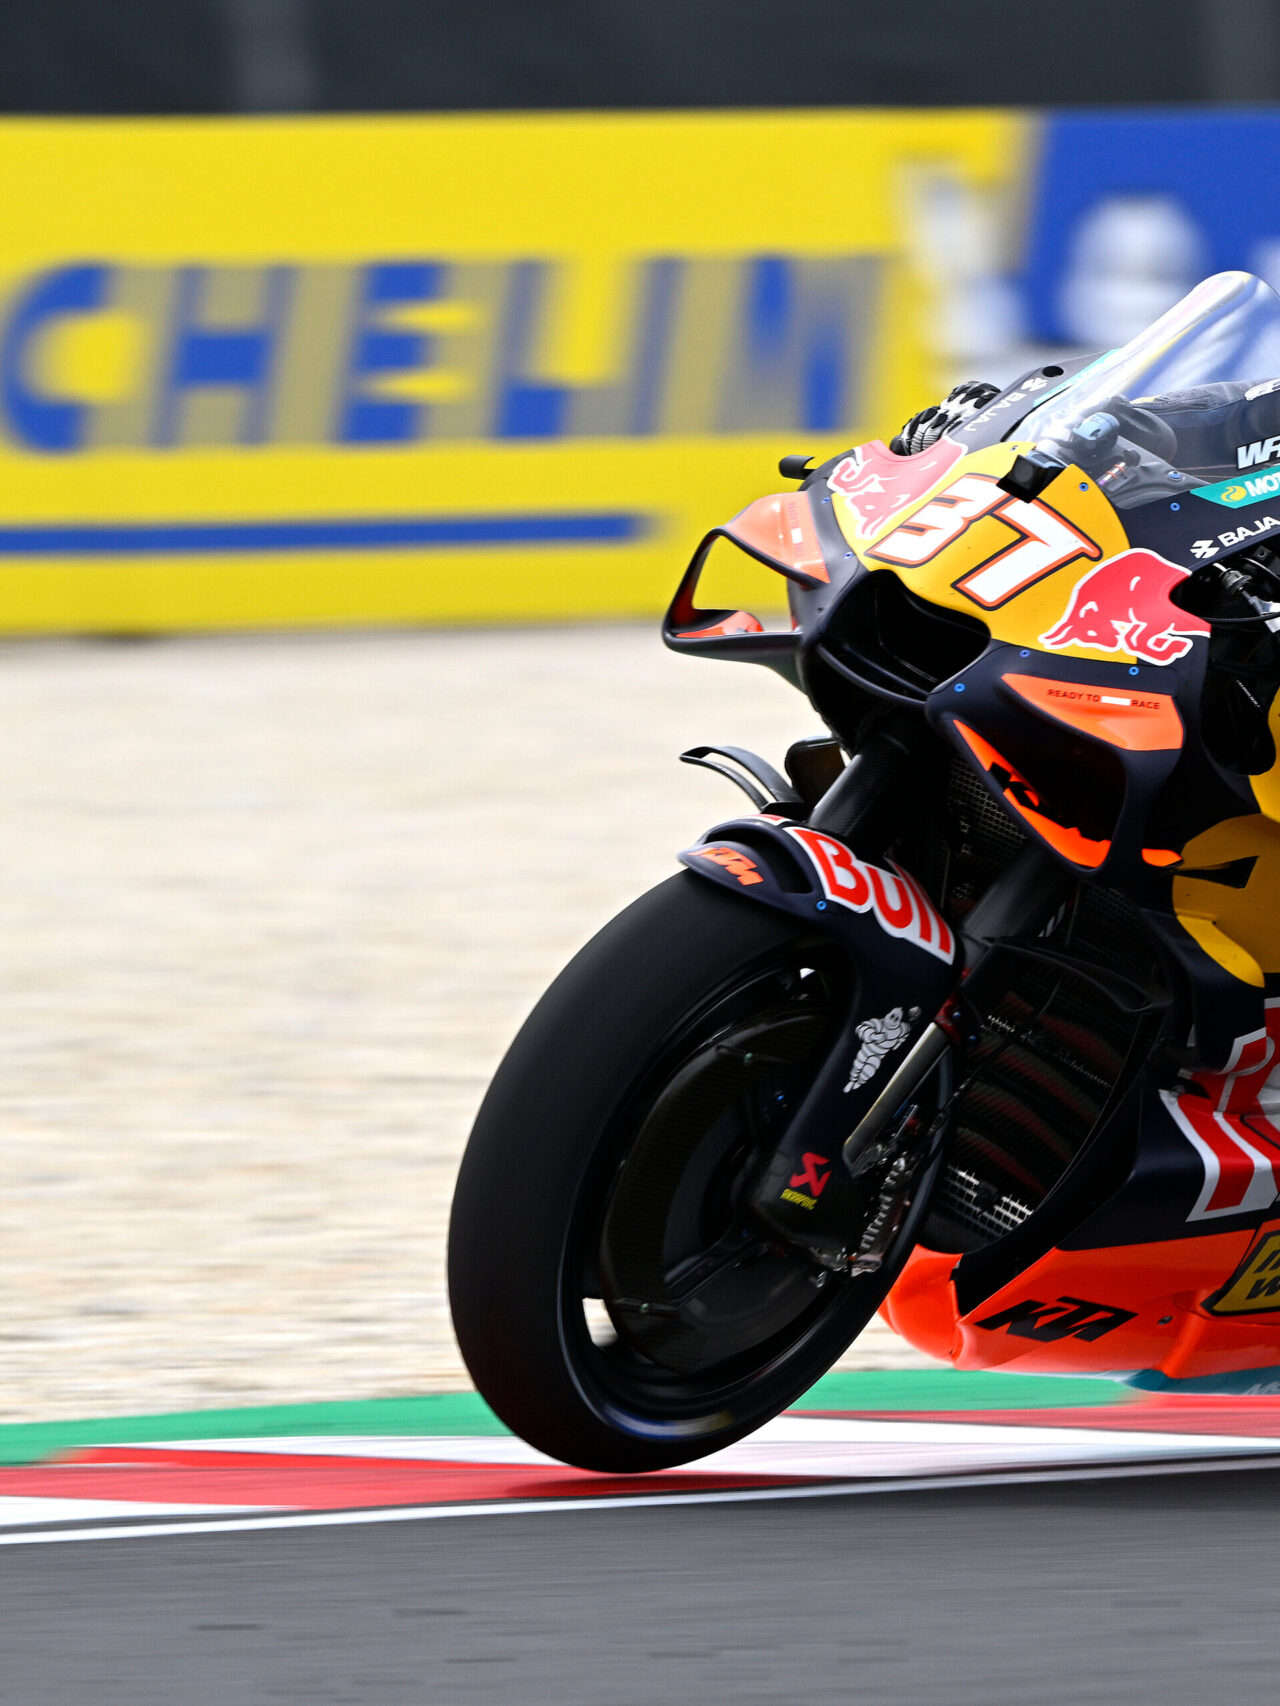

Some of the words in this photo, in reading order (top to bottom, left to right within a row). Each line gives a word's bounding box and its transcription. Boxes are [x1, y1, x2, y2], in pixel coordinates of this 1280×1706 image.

[865, 473, 1103, 611] 37
[1047, 688, 1082, 700] READY
[1086, 693, 1101, 703] TO
[1130, 699, 1161, 710] RACE
[690, 847, 765, 886] KTM
[784, 825, 956, 965] Bull
